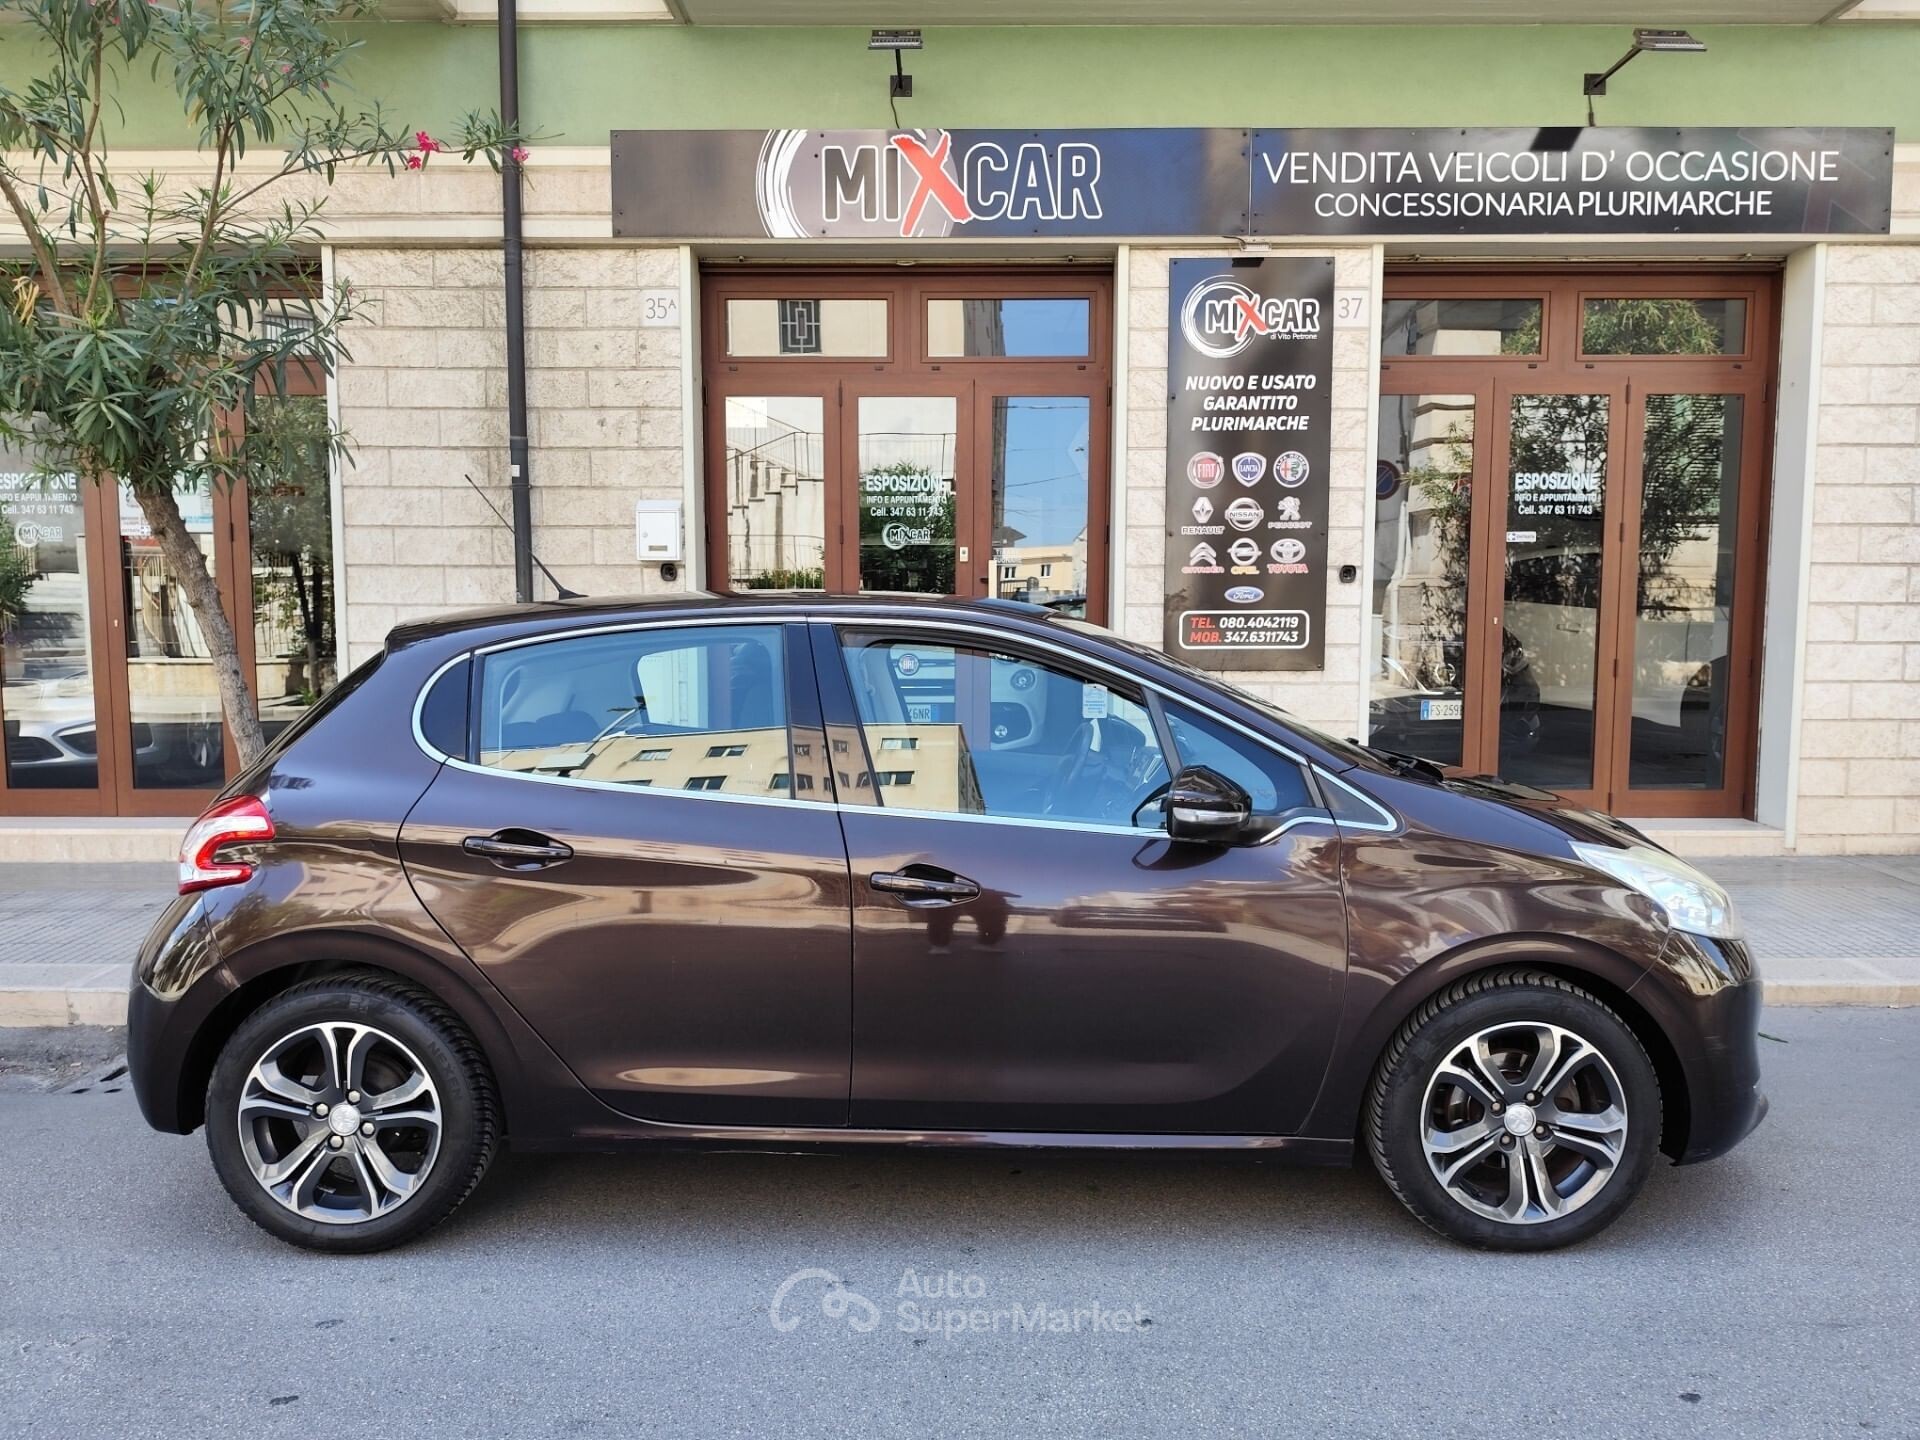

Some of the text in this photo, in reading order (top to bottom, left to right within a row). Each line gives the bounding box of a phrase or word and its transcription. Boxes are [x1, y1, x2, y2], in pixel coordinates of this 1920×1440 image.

[1263, 151, 1422, 184] VENDITA
[1428, 150, 1567, 183] VEICOLI
[1625, 150, 1839, 182] OCCASIONE
[821, 132, 1102, 237] MIXCAR
[1314, 190, 1772, 217] CONCESSIONARIA PLURIMARCHE
[1338, 297, 1362, 319] 37
[1206, 295, 1320, 341] MIXCAR
[1185, 374, 1317, 391] NUOVO E USATO
[1203, 395, 1298, 411] GARANTITO
[1190, 415, 1310, 431] PLURIMARCHE
[1197, 463, 1216, 478] FIAT
[1240, 464, 1258, 472] LANCIA
[866, 475, 947, 492] ESPOSIZIONE
[1515, 472, 1598, 490] ESPOSIZIONE
[866, 496, 883, 504] INFO
[1539, 493, 1597, 502] APPUNTAMENTO
[22, 505, 35, 514] 347
[37, 505, 47, 514] 63
[49, 505, 57, 514] 11
[60, 505, 74, 514] 743
[870, 507, 888, 516] Cell.
[890, 507, 904, 516] 347
[906, 507, 916, 517] 63
[918, 508, 926, 516] 11
[1518, 505, 1593, 514] Cell. 347 63 11 743
[1181, 526, 1225, 534] RENAULT
[1267, 563, 1309, 574] TOYOTA
[1233, 589, 1256, 600] Ford
[1190, 617, 1299, 628] TEL. 080.4042119
[1190, 631, 1298, 643] MOB. 347.6311743
